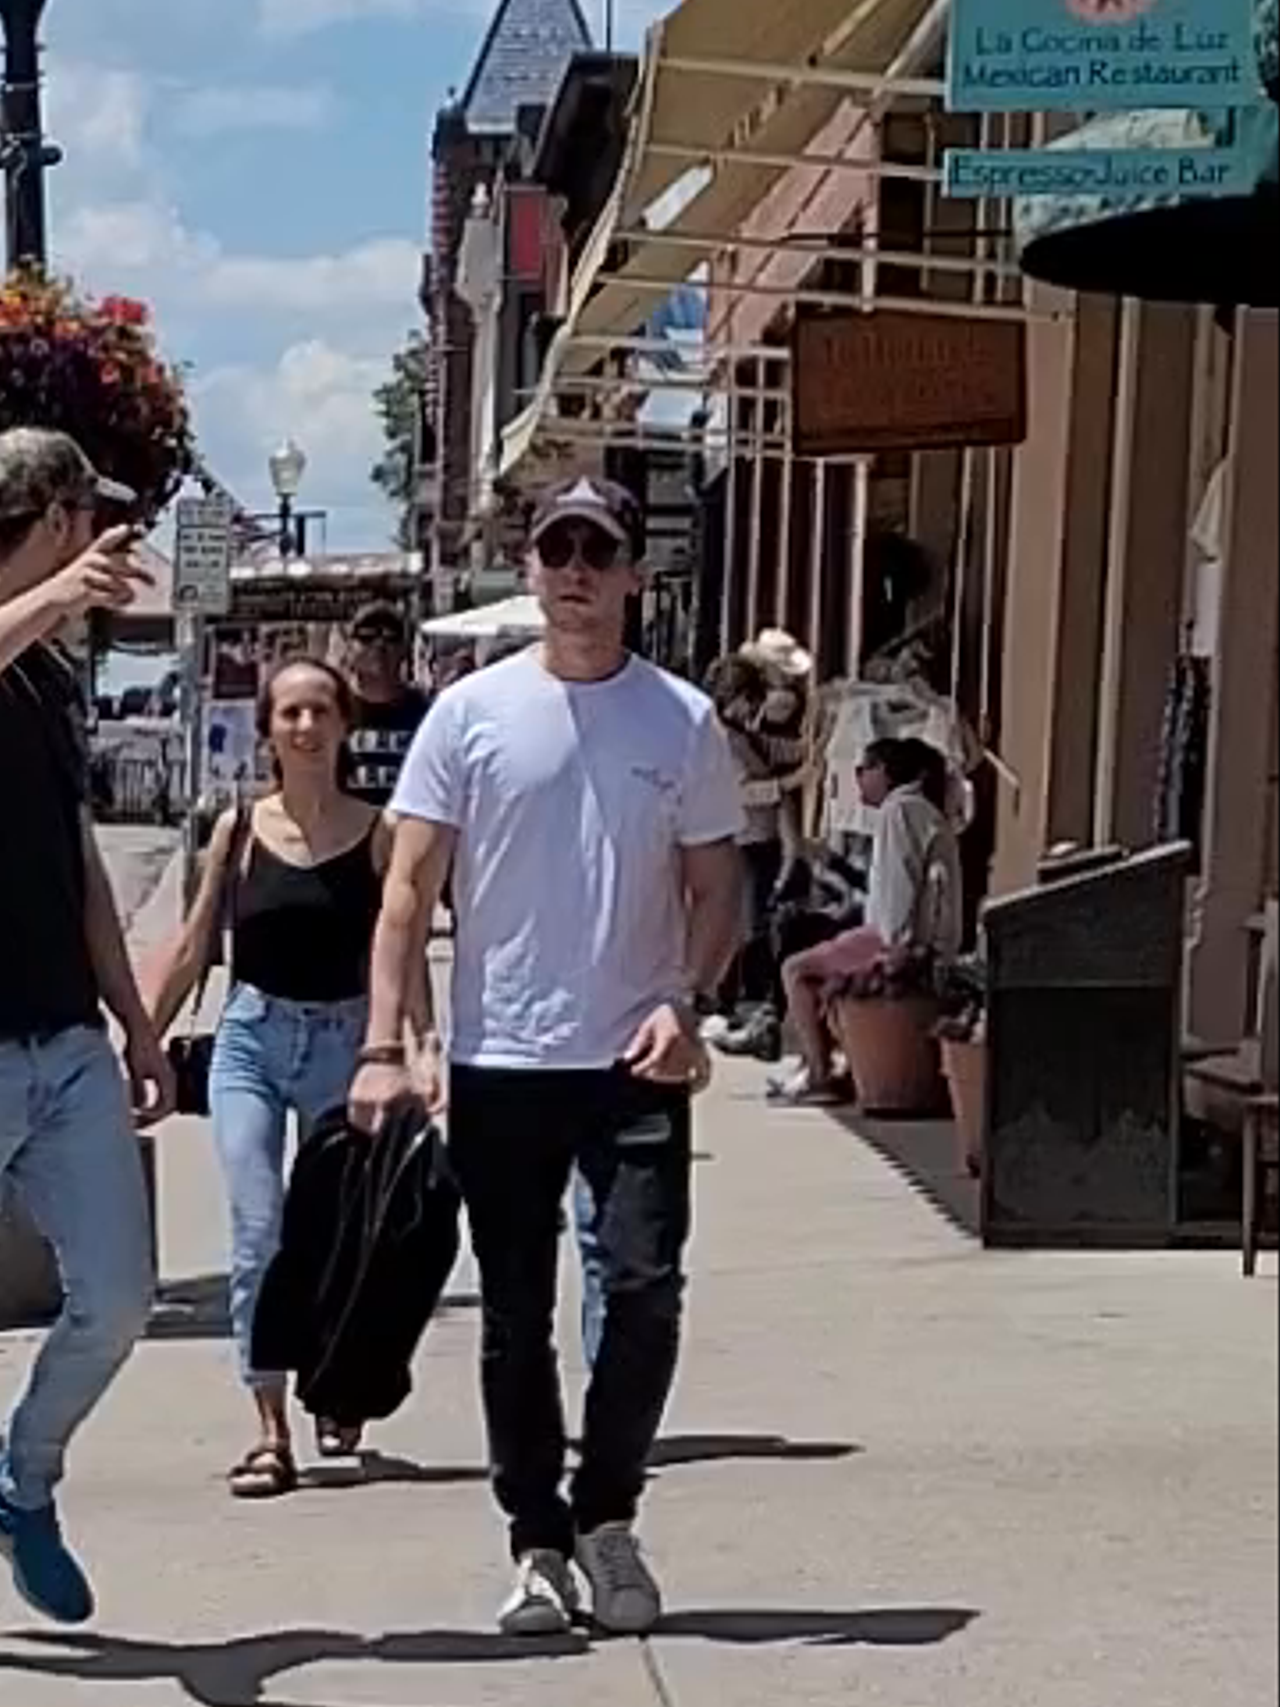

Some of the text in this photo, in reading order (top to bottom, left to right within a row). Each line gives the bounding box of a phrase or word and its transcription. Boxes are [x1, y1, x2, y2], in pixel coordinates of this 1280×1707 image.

[976, 22, 1228, 56] La Cocina de Luz
[963, 56, 1241, 87] Mexican Restaurant
[1178, 157, 1230, 184] Bar
